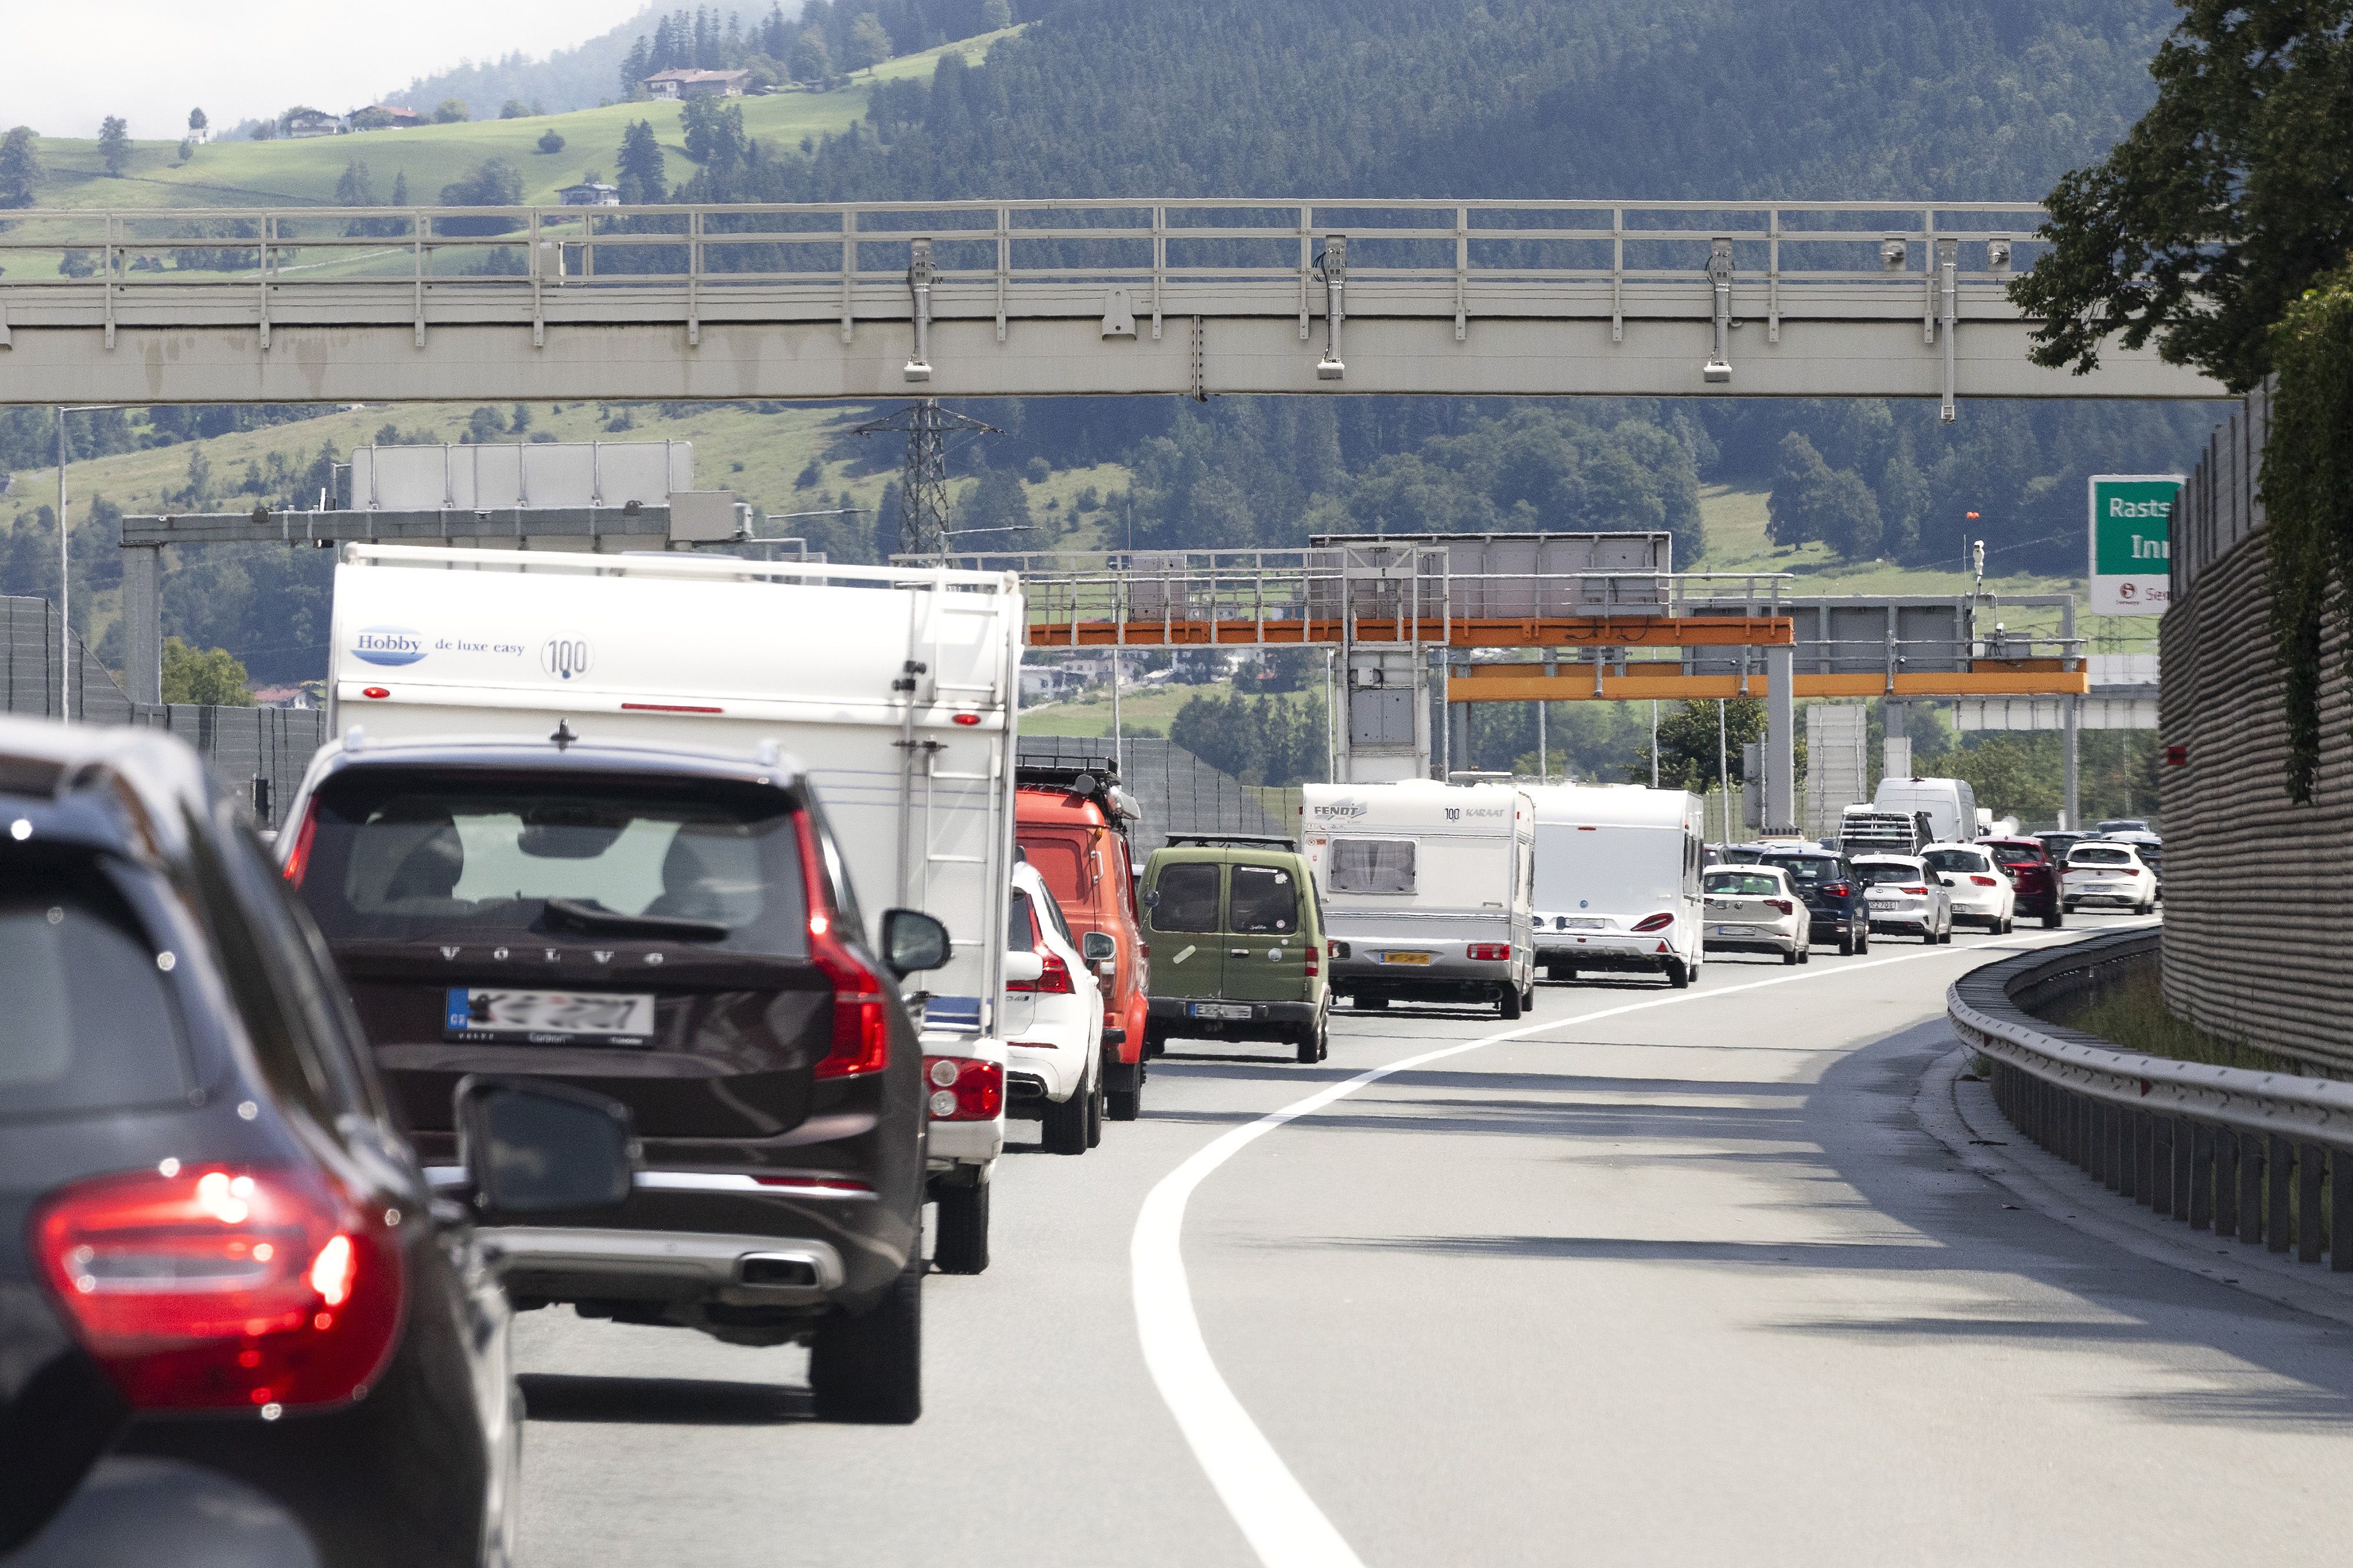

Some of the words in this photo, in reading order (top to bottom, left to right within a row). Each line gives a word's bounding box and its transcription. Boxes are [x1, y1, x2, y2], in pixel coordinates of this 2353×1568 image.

[358, 635, 422, 655] Hobby
[435, 639, 453, 650] de
[457, 639, 488, 652] luxe
[494, 643, 525, 656] easy
[548, 640, 588, 673] 100
[1314, 806, 1358, 815] FENDT
[1445, 808, 1460, 820] 100
[439, 946, 664, 966] VOLVO
